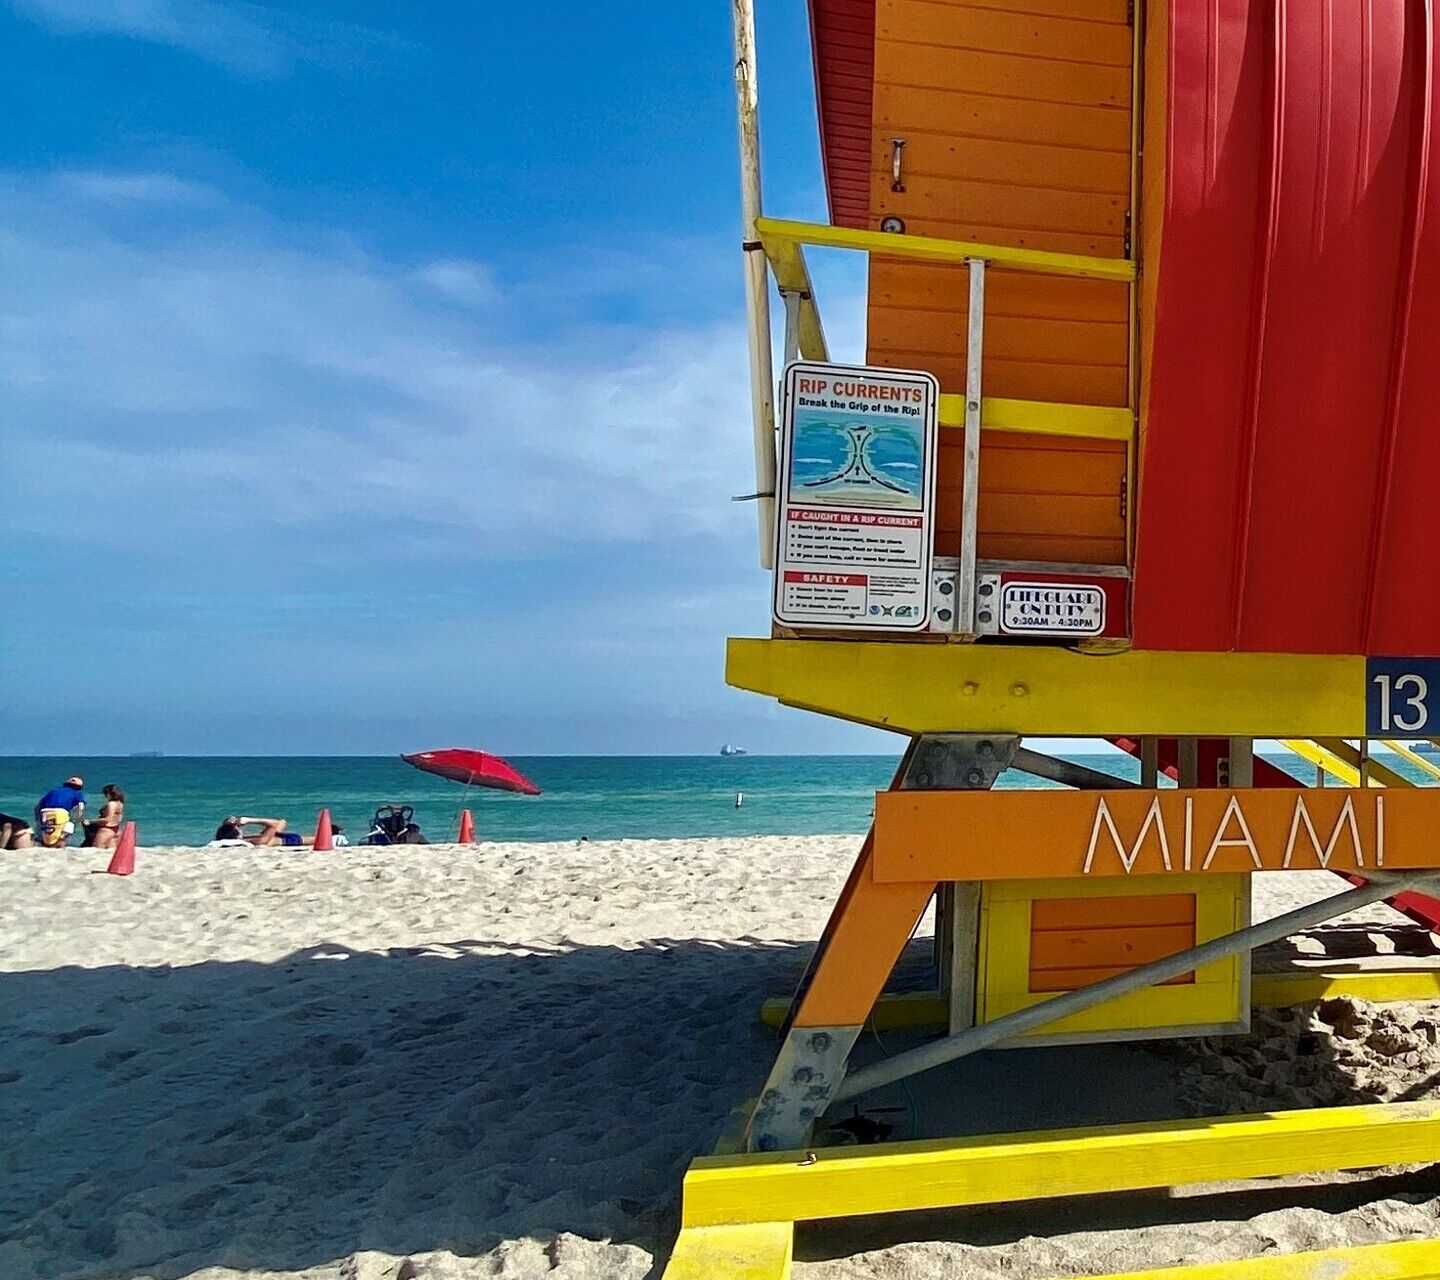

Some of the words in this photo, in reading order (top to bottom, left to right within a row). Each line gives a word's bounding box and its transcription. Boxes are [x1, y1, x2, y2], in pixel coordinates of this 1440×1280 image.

[800, 379, 827, 394] RIP
[833, 381, 922, 402] CURRENTS
[799, 397, 828, 408] Break
[830, 400, 846, 410] the
[849, 401, 869, 412] Grip
[871, 404, 881, 412] of
[884, 404, 899, 413] the
[902, 406, 920, 416] Rip!
[791, 511, 799, 519] IF
[801, 512, 839, 522] CAUGHT
[840, 514, 851, 522] IN
[852, 515, 860, 523] A
[861, 515, 876, 524] RIP
[877, 517, 919, 526] CURRENT
[803, 574, 850, 583] SAFETY
[1010, 590, 1097, 604] LIFEGUARD
[1020, 604, 1041, 614] ON
[1045, 604, 1087, 616] DUTY
[1012, 617, 1049, 626] 9:30AM
[1058, 618, 1093, 627] 4:30PM
[1373, 674, 1428, 731] 13
[1083, 795, 1385, 874] MIAMI
